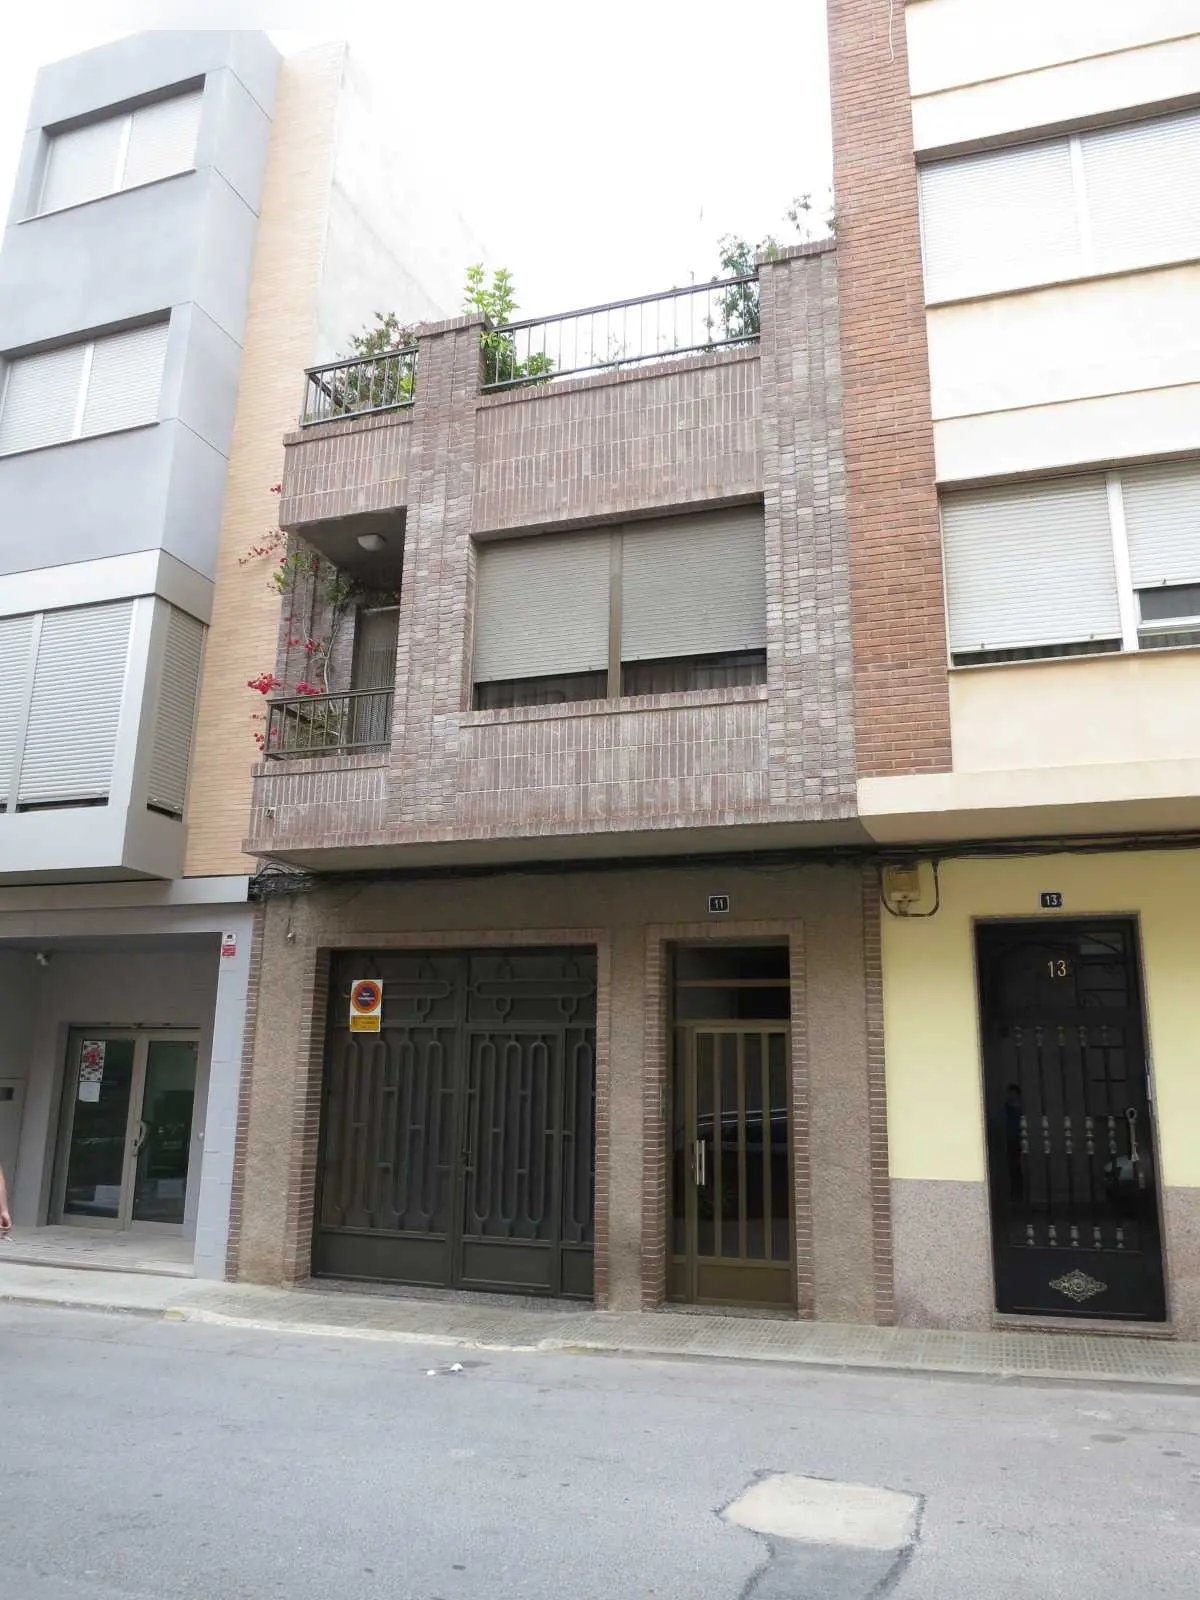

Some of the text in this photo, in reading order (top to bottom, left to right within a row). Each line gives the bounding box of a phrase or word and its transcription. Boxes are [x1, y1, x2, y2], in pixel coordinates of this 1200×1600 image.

[715, 899, 724, 910] 11
[1045, 894, 1058, 906] 13
[1048, 960, 1067, 978] 13
